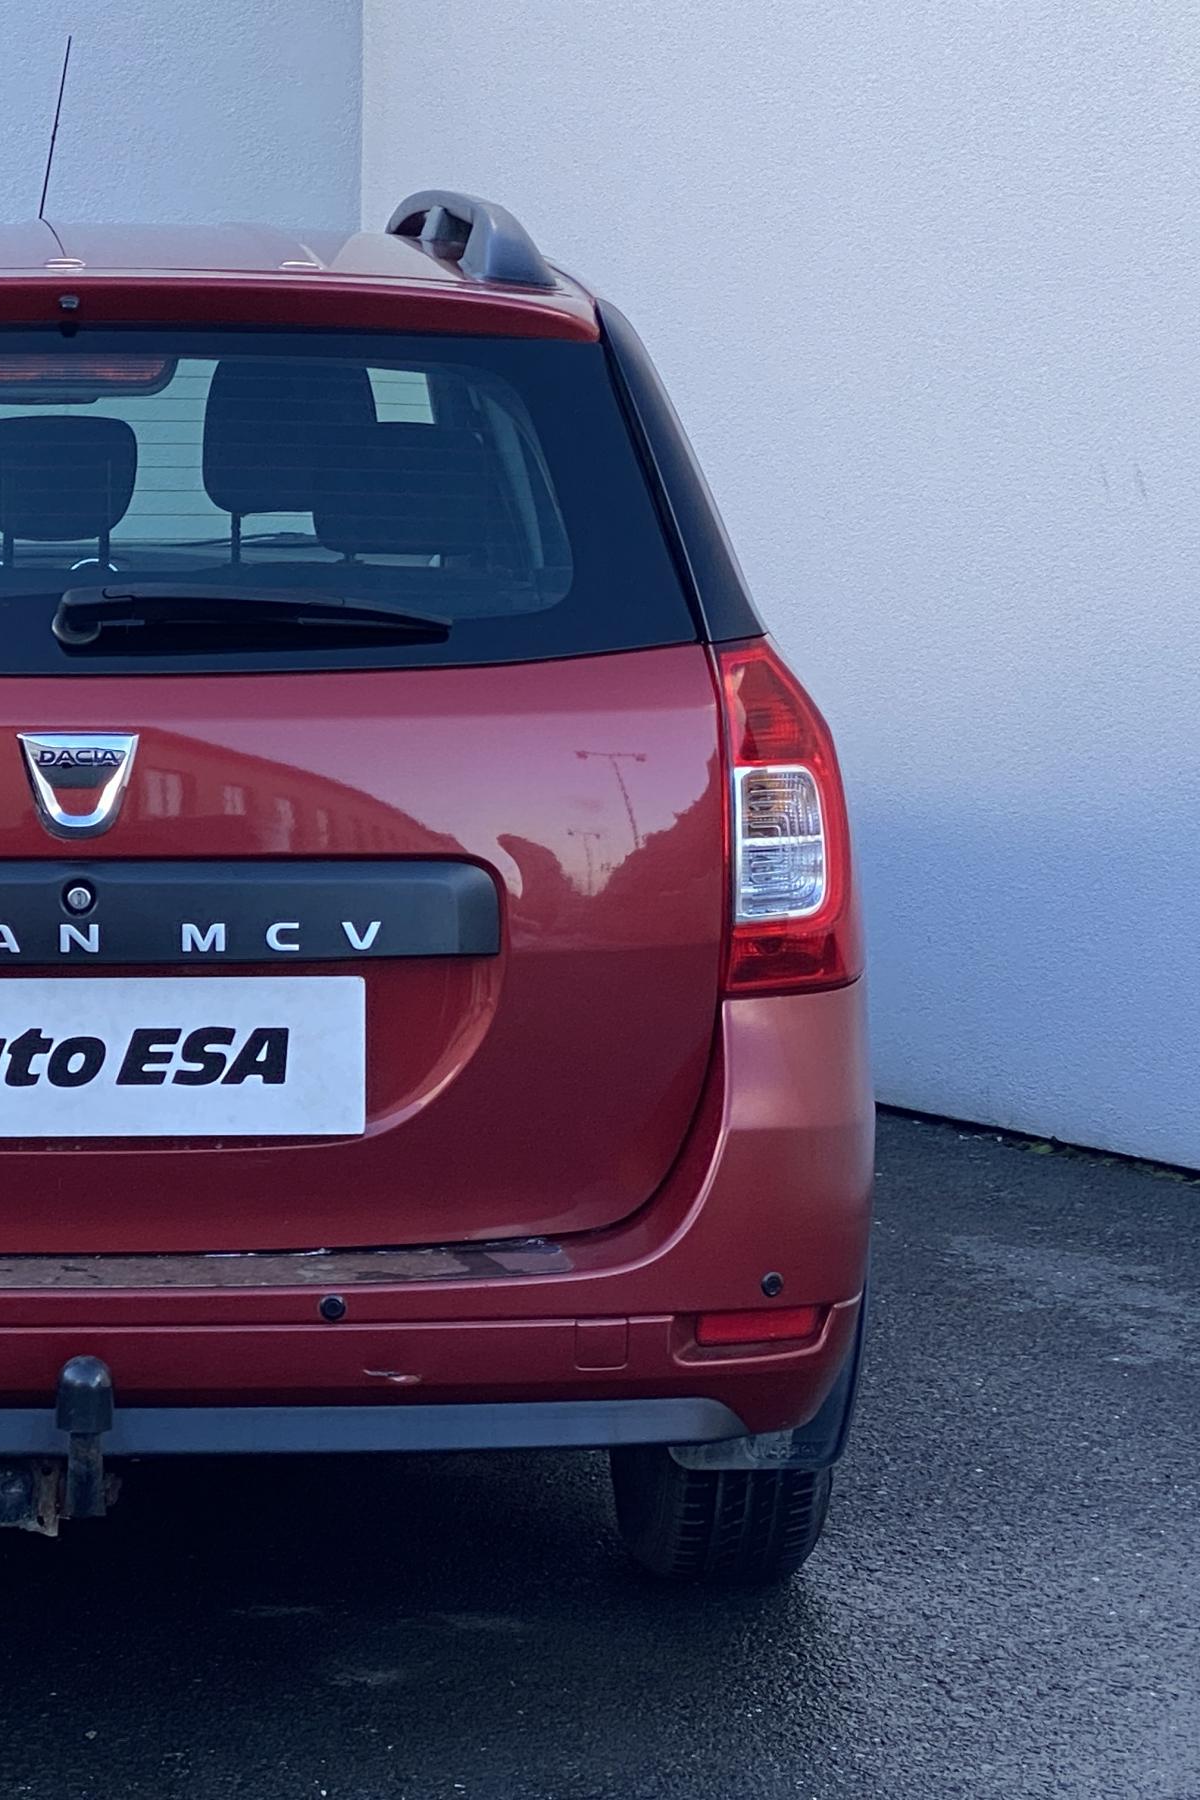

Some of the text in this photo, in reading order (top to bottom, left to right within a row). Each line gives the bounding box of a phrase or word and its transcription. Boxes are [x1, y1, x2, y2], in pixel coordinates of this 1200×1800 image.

[39, 750, 120, 766] DACIA
[180, 920, 383, 952] MCV
[115, 1026, 290, 1086] ESA
